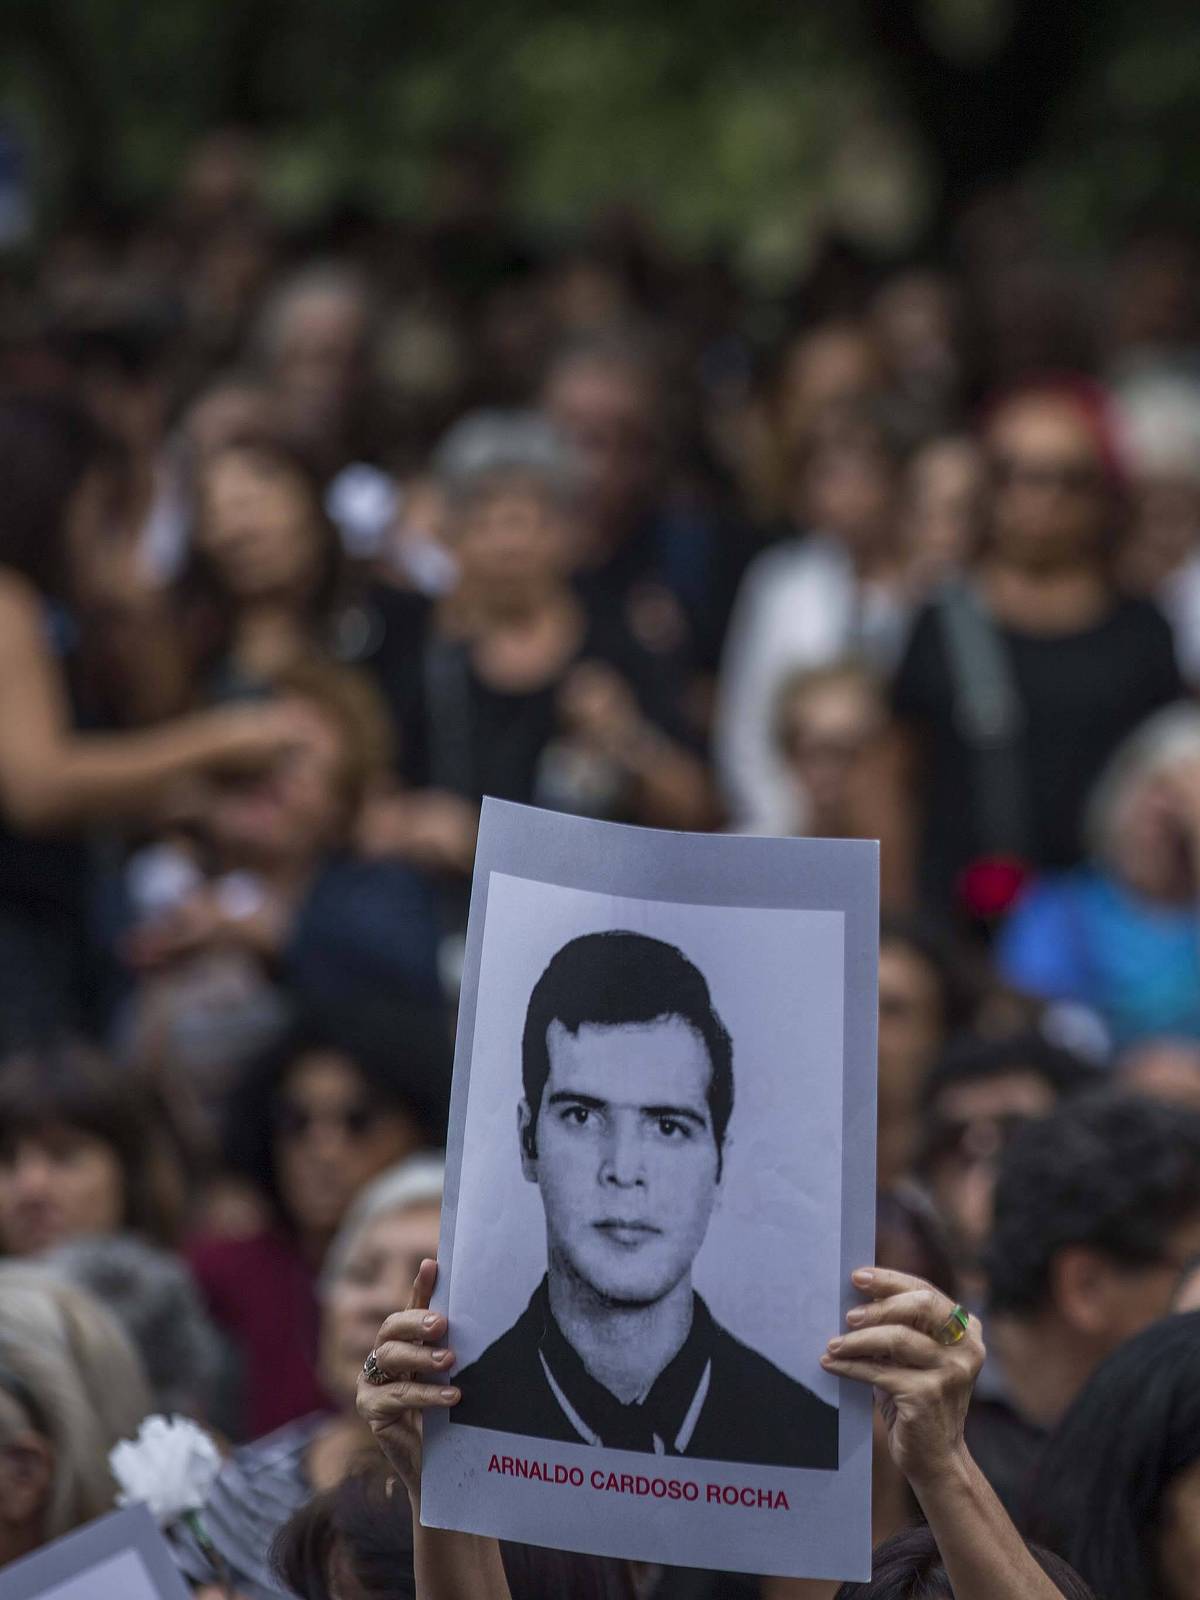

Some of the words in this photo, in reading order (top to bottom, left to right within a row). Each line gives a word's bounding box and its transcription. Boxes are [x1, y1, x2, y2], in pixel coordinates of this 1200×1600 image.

[488, 1454, 584, 1486] ARNALDO
[590, 1470, 699, 1501] CARDOSO
[706, 1484, 790, 1510] ROCHA
